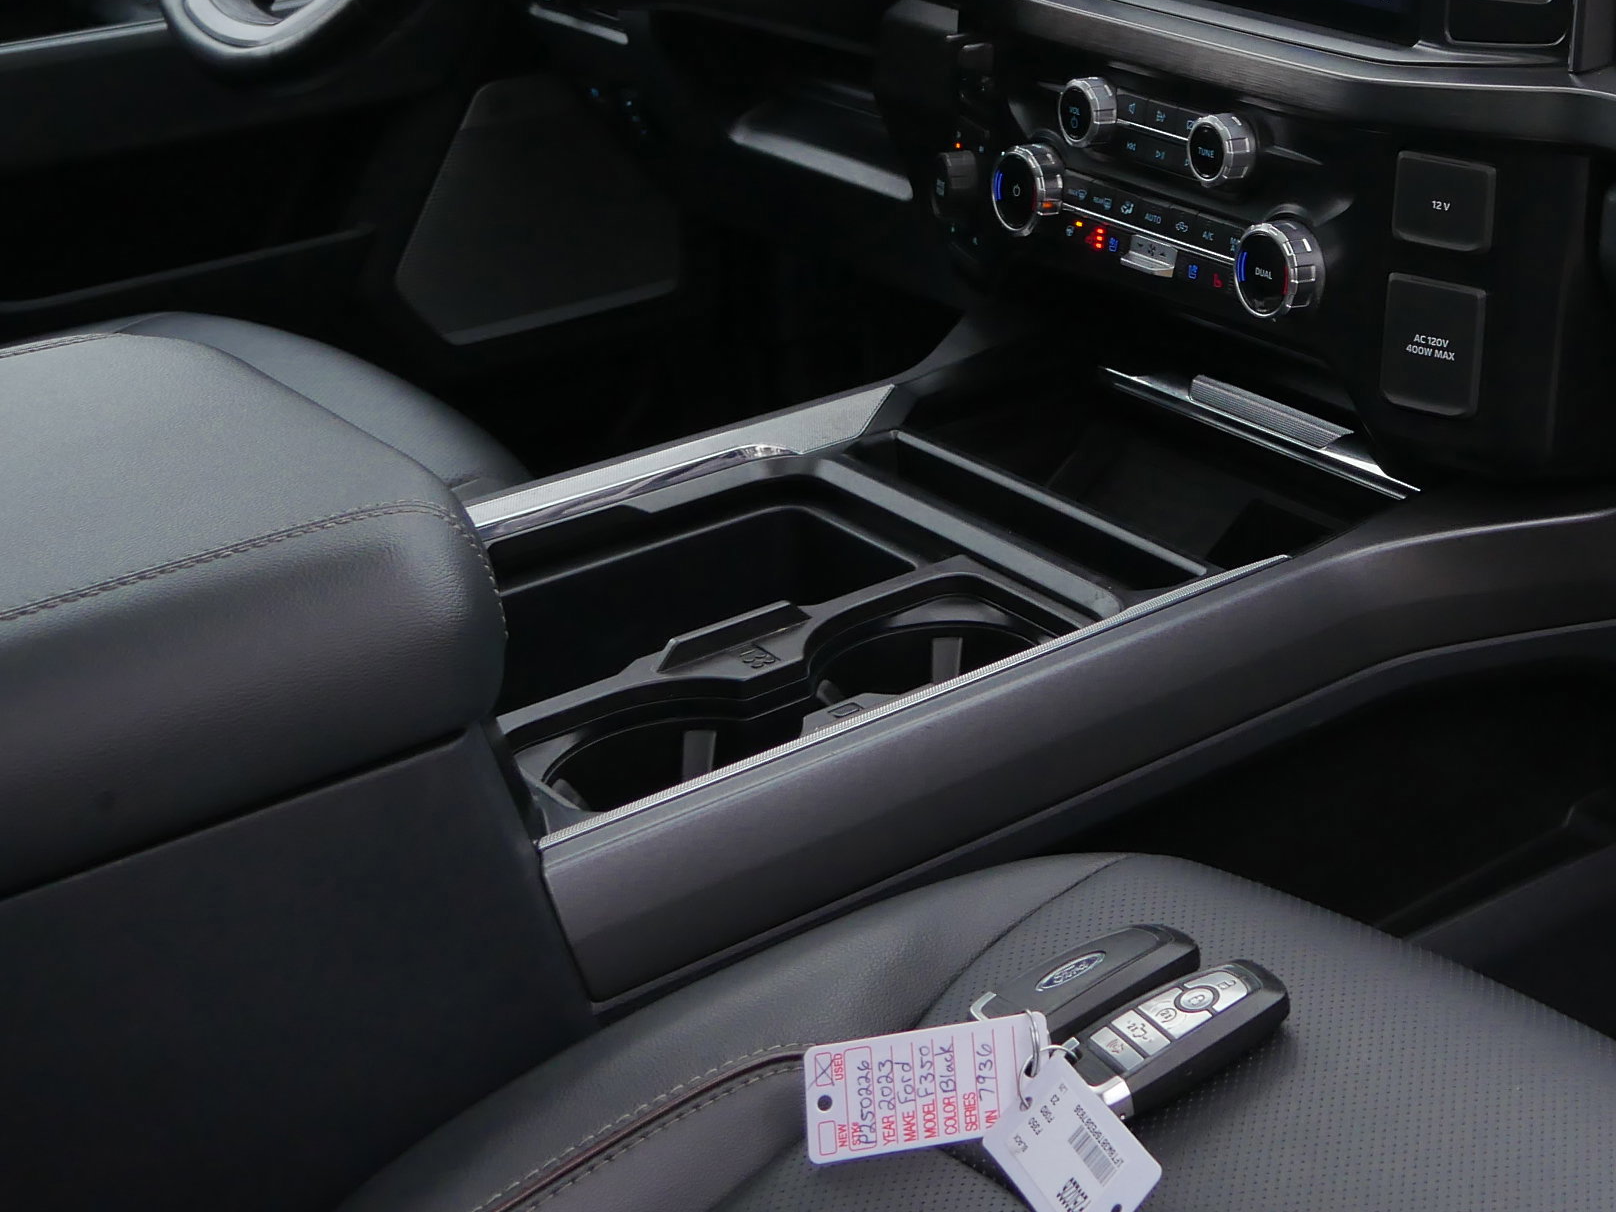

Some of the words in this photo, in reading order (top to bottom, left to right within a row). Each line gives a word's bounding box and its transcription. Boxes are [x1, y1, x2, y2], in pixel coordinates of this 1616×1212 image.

[1069, 106, 1080, 116] VOL
[1197, 146, 1215, 159] TUNE
[1431, 200, 1442, 210] 12
[1443, 202, 1451, 211] V
[1144, 212, 1162, 225] AUTO
[1202, 231, 1214, 242] A/C
[1254, 266, 1273, 280] DUAL
[1413, 333, 1426, 344] AC
[1427, 336, 1450, 349] 120V
[1405, 343, 1433, 357] 400W
[1434, 348, 1456, 362] MAX
[833, 1053, 844, 1081] USED
[917, 1045, 936, 1098] F350
[935, 1043, 956, 1093] Black
[976, 1043, 997, 1102] 7936
[877, 1059, 896, 1111] 2023
[895, 1061, 916, 1105] Ford
[857, 1060, 877, 1145] P250226
[1050, 1094, 1060, 1106] 23
[922, 1099, 937, 1139] MODEL
[943, 1095, 957, 1135] COLOR
[963, 1091, 979, 1132] SERIES
[985, 1109, 998, 1129] VIN
[1040, 1105, 1055, 1124] FORD
[837, 1124, 848, 1148] NEW
[881, 1115, 896, 1146] YEAR
[902, 1110, 917, 1142] MAKE
[1028, 1117, 1043, 1136] F350
[1013, 1134, 1029, 1152] BLACK
